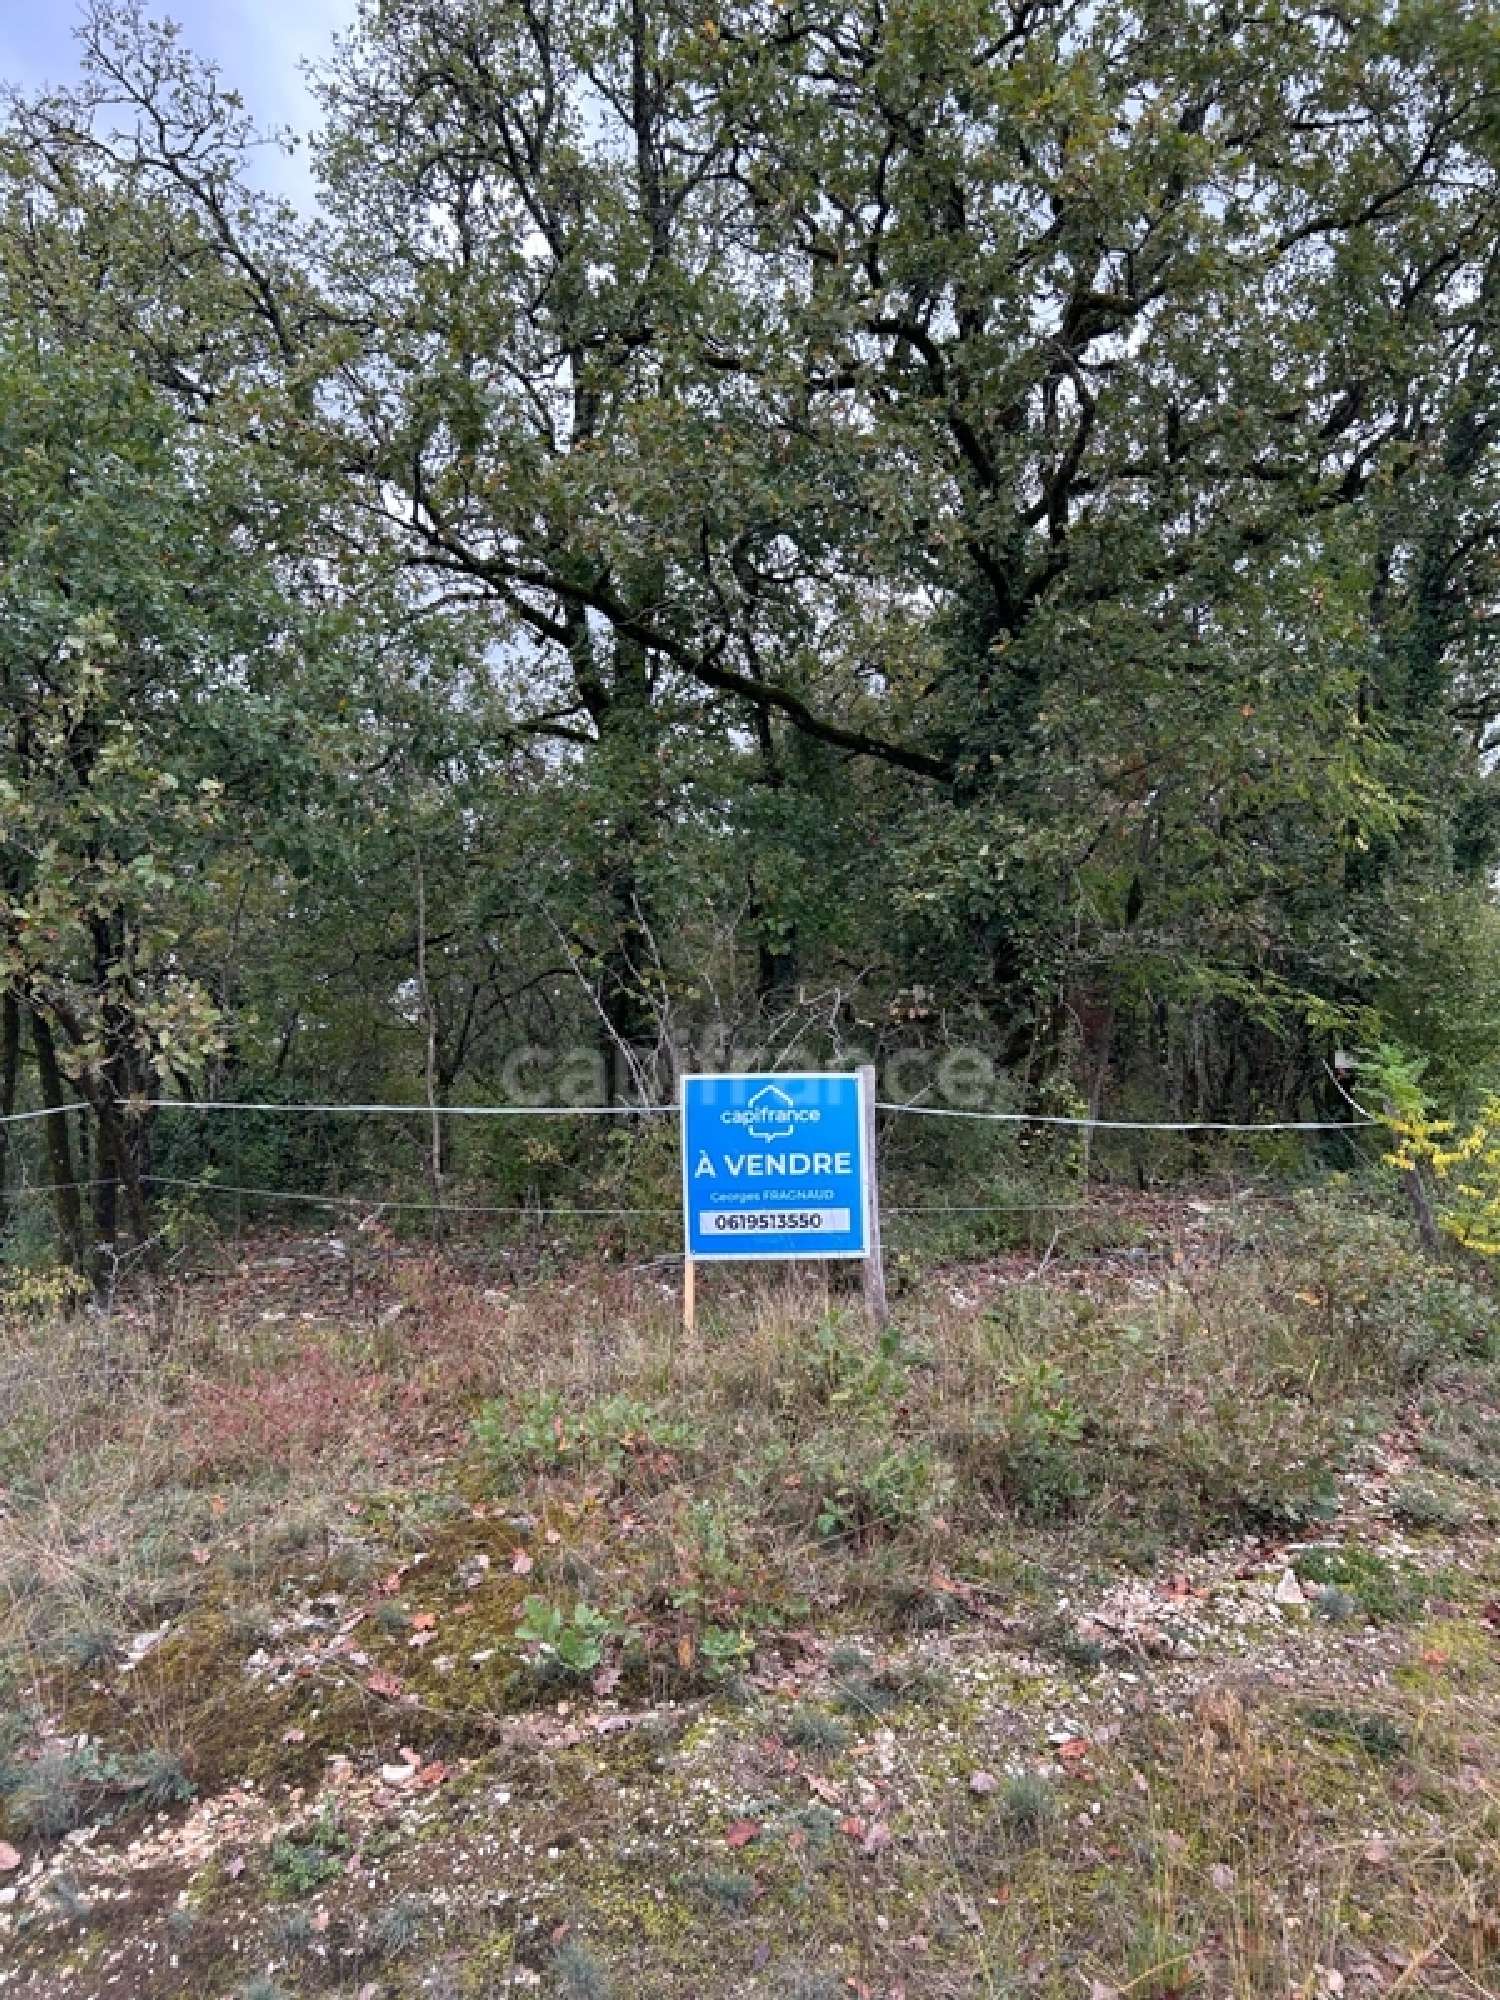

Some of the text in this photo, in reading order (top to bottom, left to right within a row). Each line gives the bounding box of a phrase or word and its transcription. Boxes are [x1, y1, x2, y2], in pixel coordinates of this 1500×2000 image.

[720, 1106, 821, 1126] capifrance
[694, 1149, 853, 1179] À VENDRE
[714, 1213, 823, 1230] 0619513550
